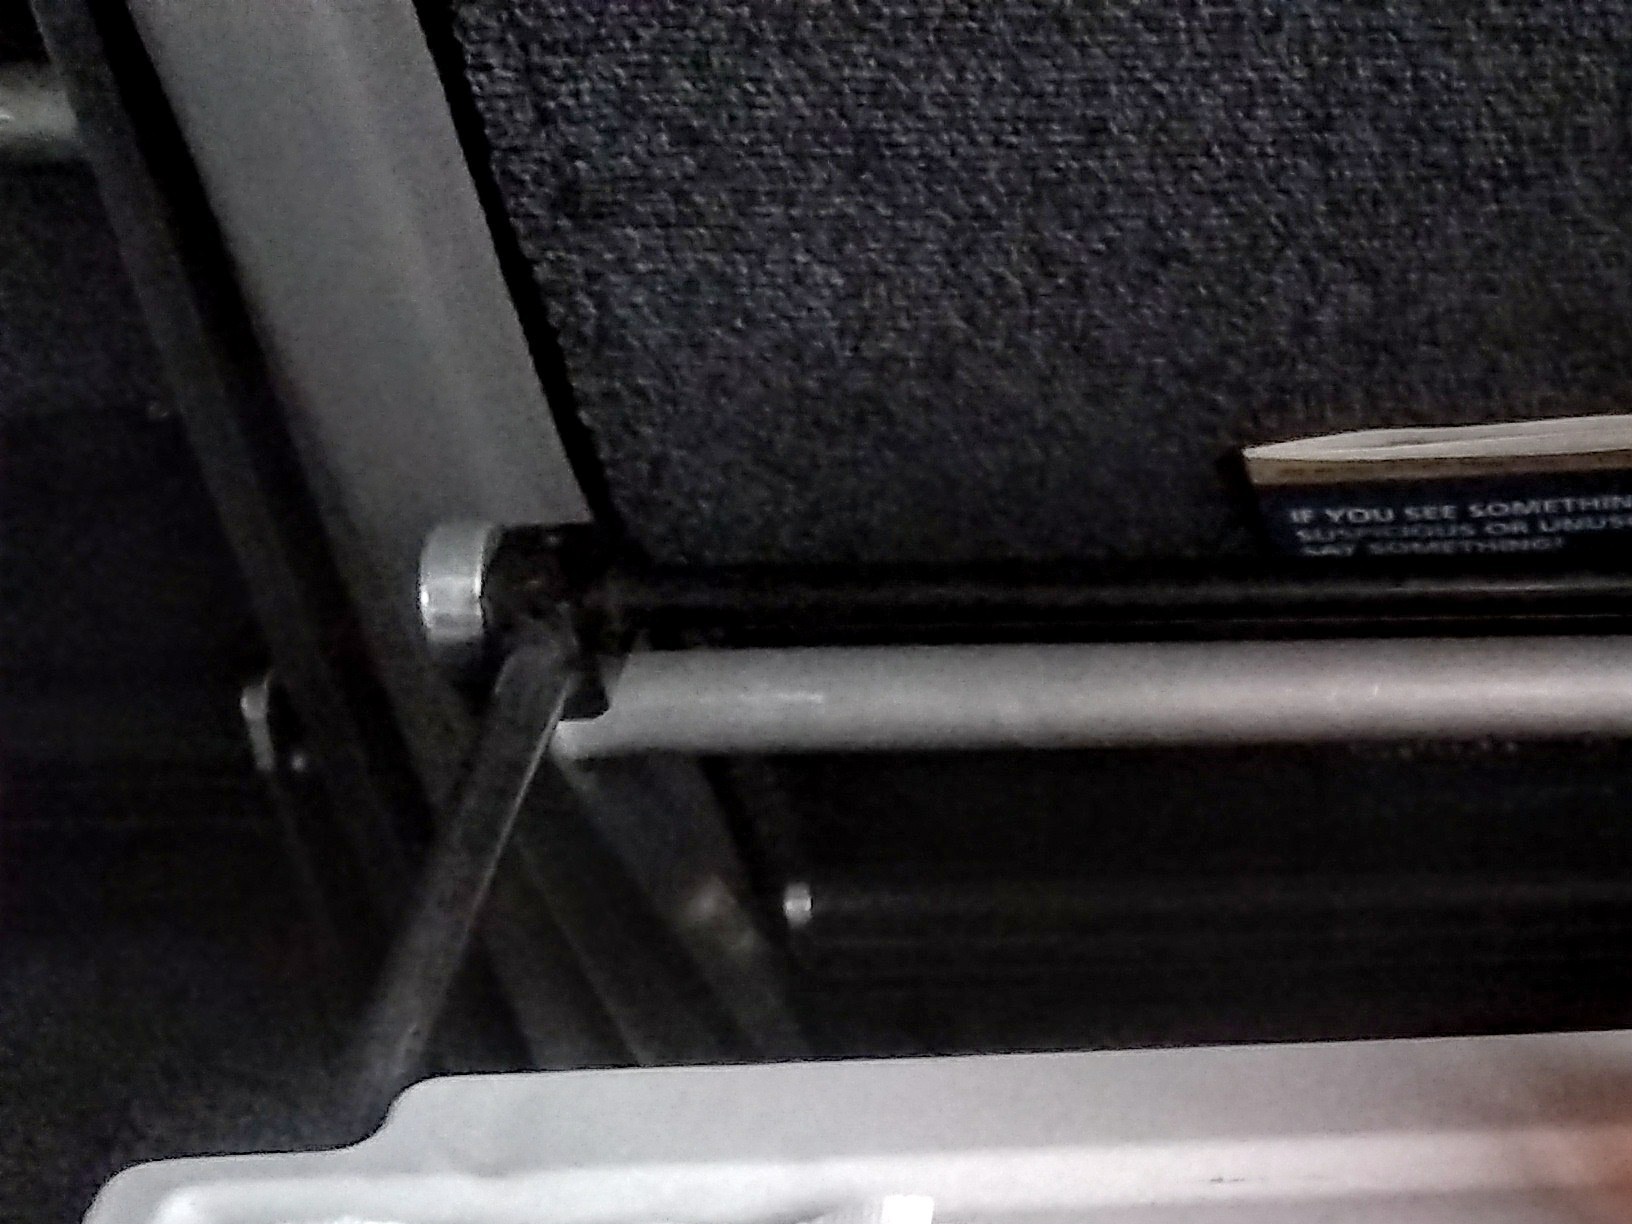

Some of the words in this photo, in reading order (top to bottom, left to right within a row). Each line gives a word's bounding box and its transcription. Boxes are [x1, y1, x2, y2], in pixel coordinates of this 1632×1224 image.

[1290, 508, 1313, 524] IF
[1324, 507, 1396, 524] YOU
[1403, 504, 1457, 521] SEE
